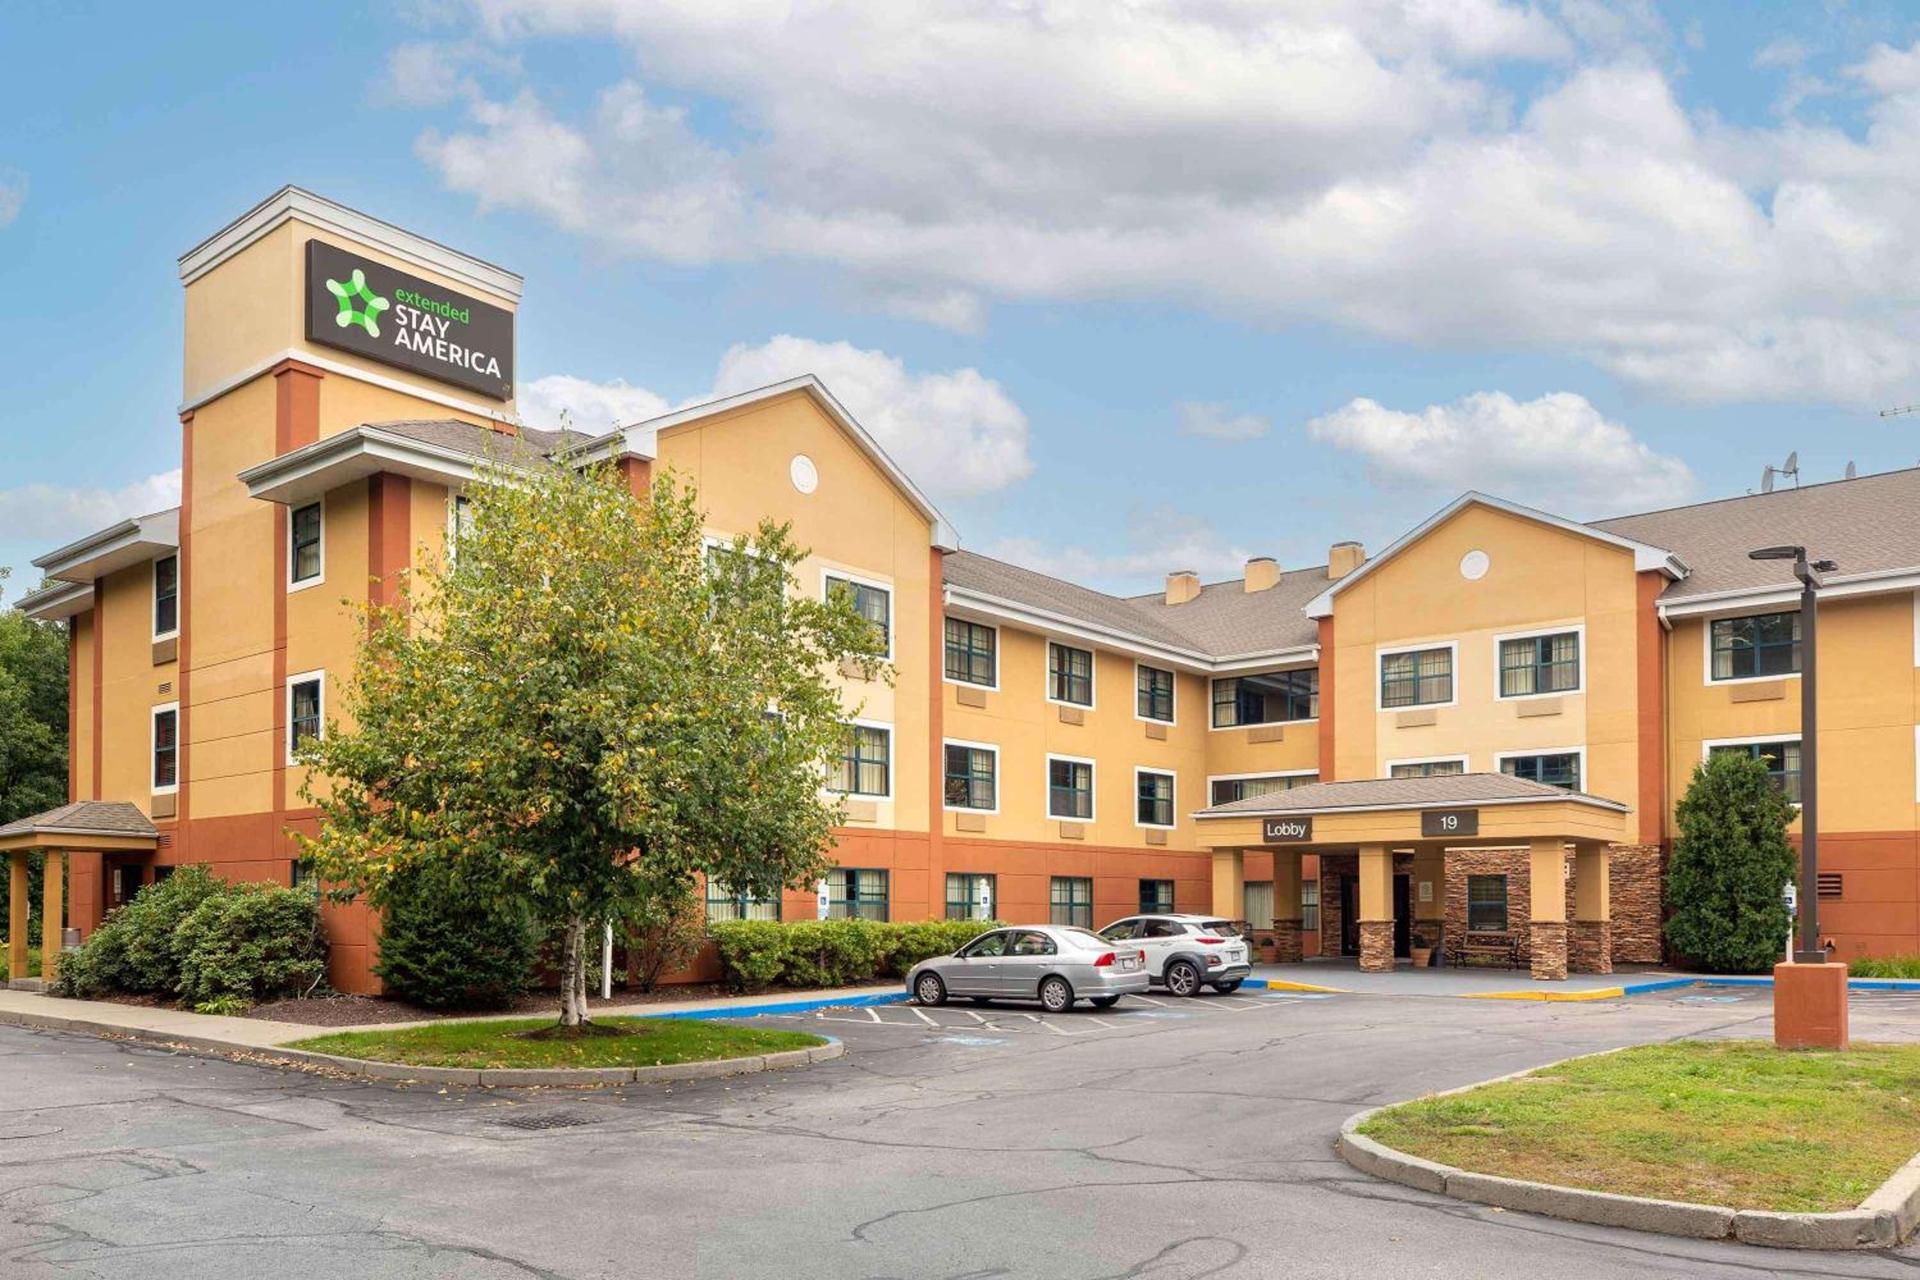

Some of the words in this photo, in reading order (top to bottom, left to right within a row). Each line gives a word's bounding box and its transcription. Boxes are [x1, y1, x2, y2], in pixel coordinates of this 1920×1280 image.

[395, 288, 469, 324] extended
[395, 304, 450, 339] STAY
[394, 327, 501, 379] AMERICA
[1267, 822, 1307, 838] Lobby
[1440, 815, 1458, 830] 19
